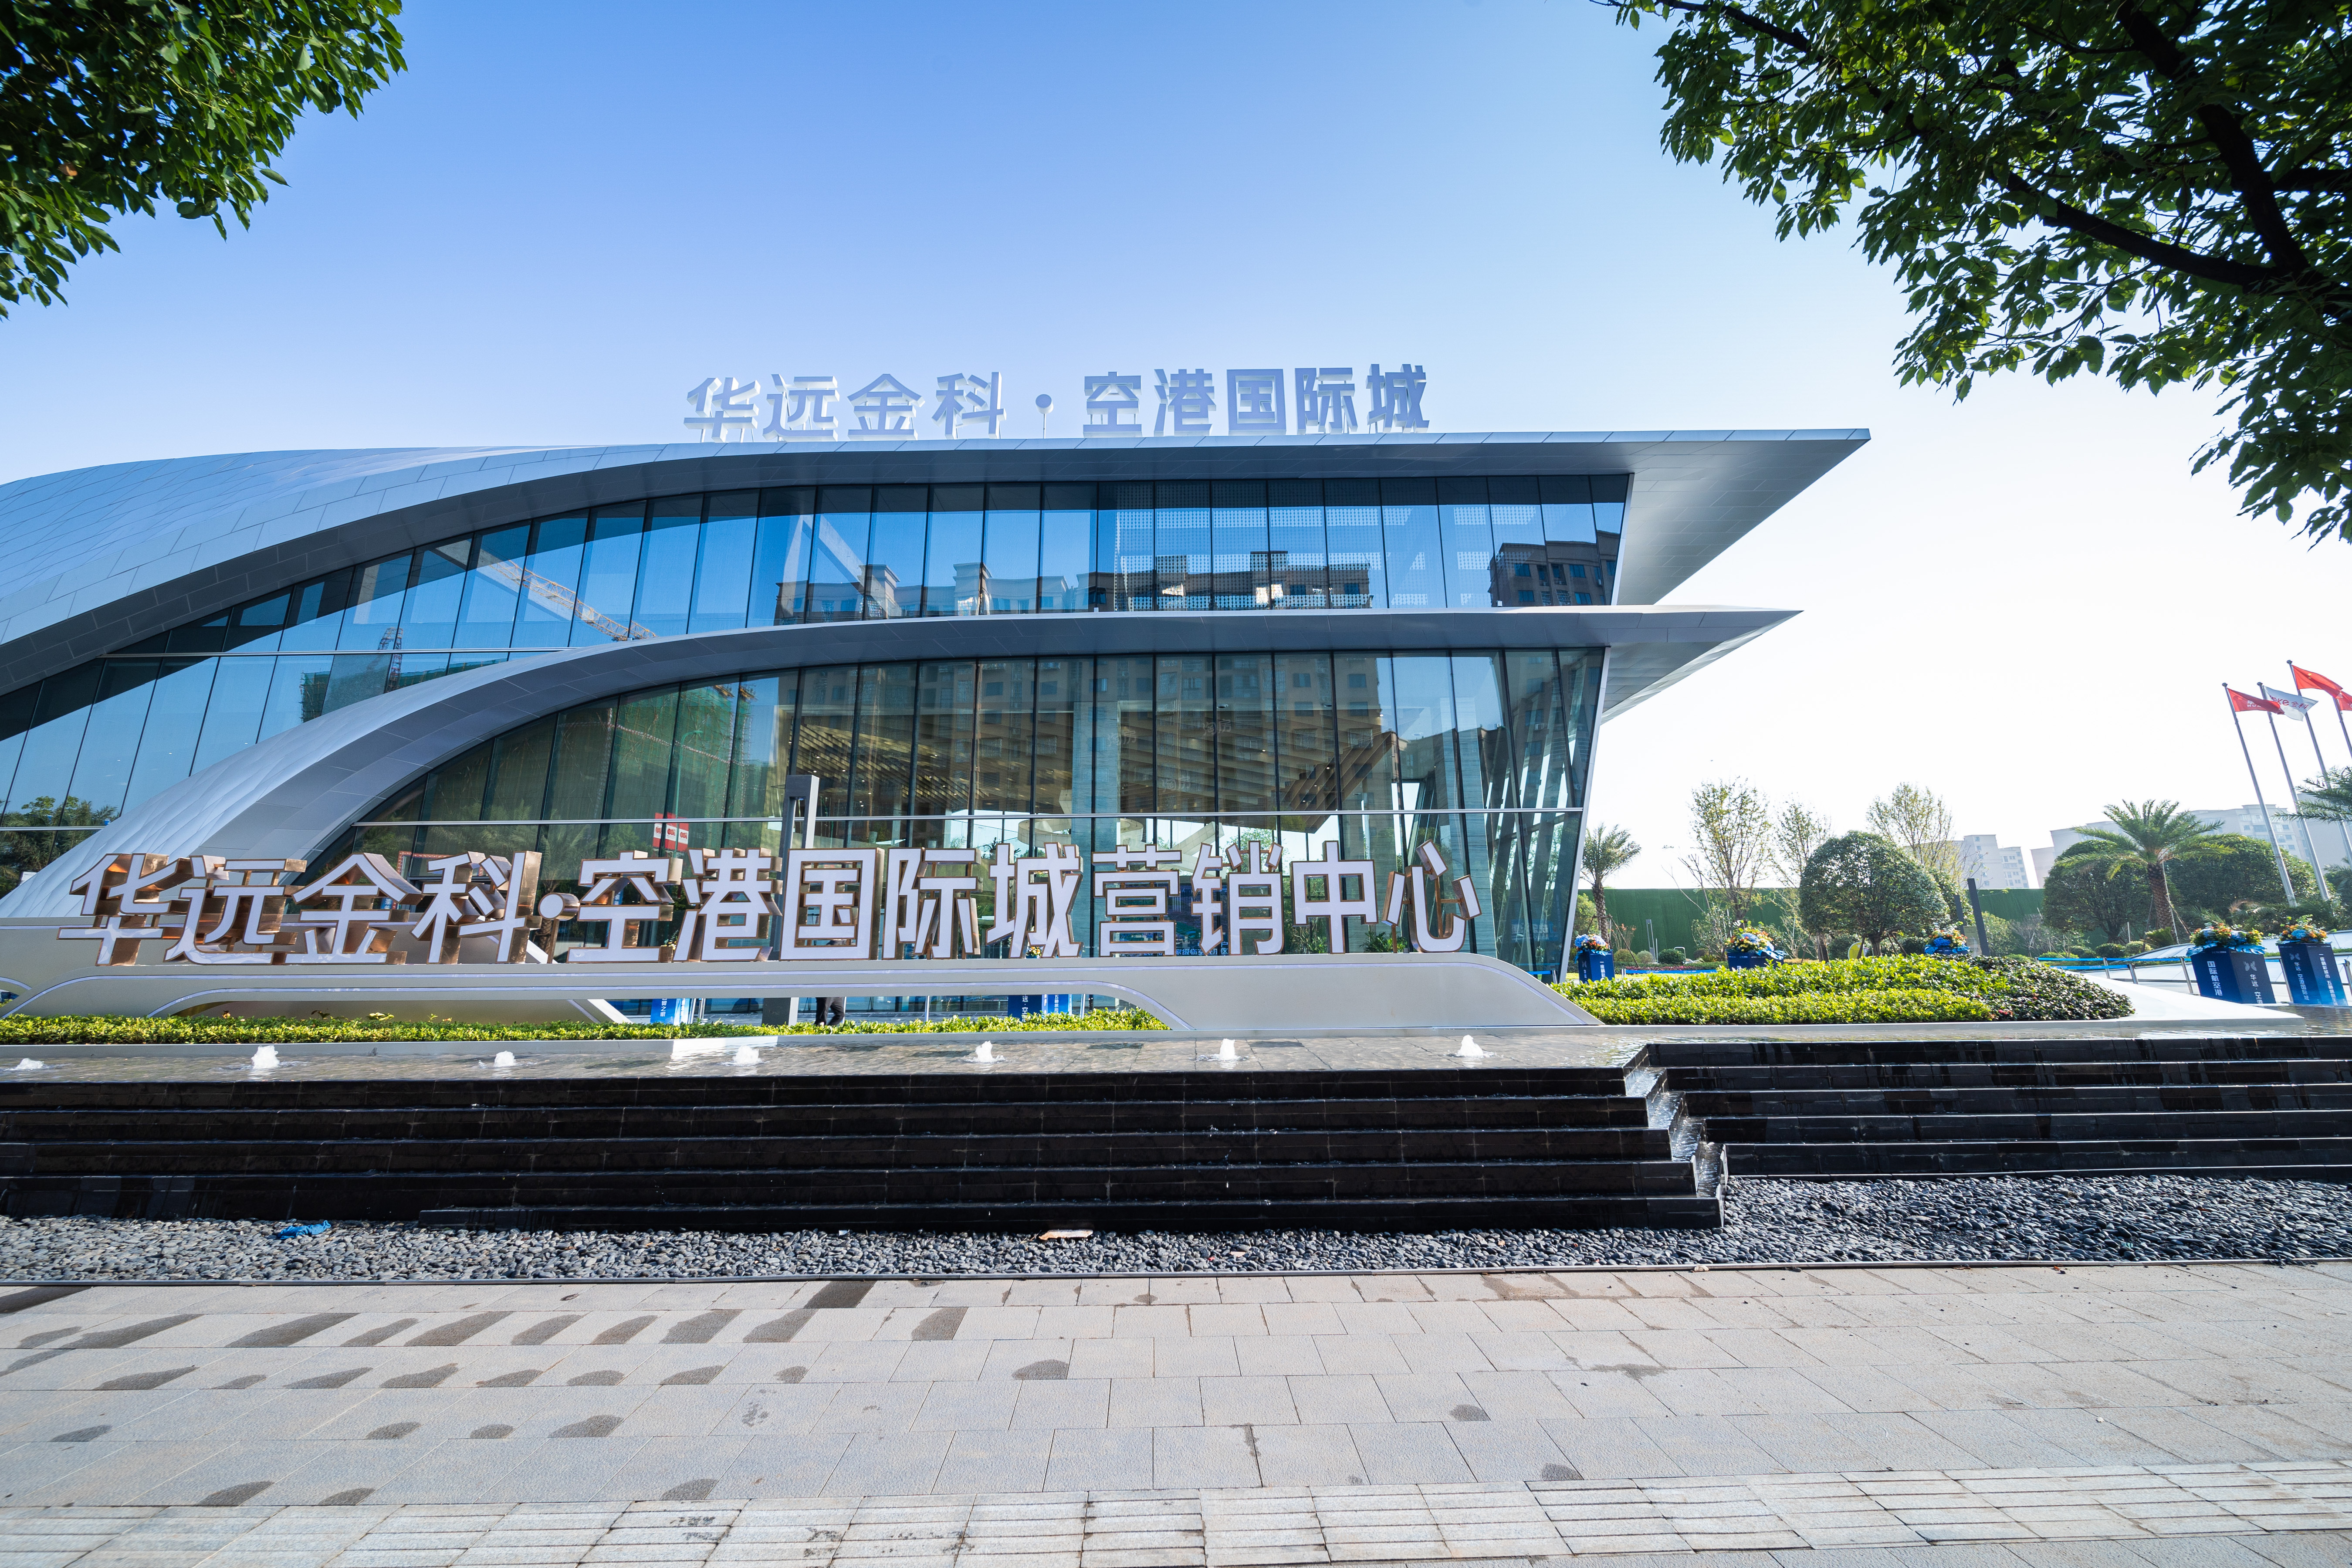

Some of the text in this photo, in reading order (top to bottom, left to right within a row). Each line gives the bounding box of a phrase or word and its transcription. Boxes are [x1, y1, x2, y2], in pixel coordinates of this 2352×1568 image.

[684, 364, 1430, 442] 华远金科·空港国际城
[57, 839, 1482, 966] 华远金科·空港国际城营销中心
[2207, 961, 2223, 996] 国际航空港
